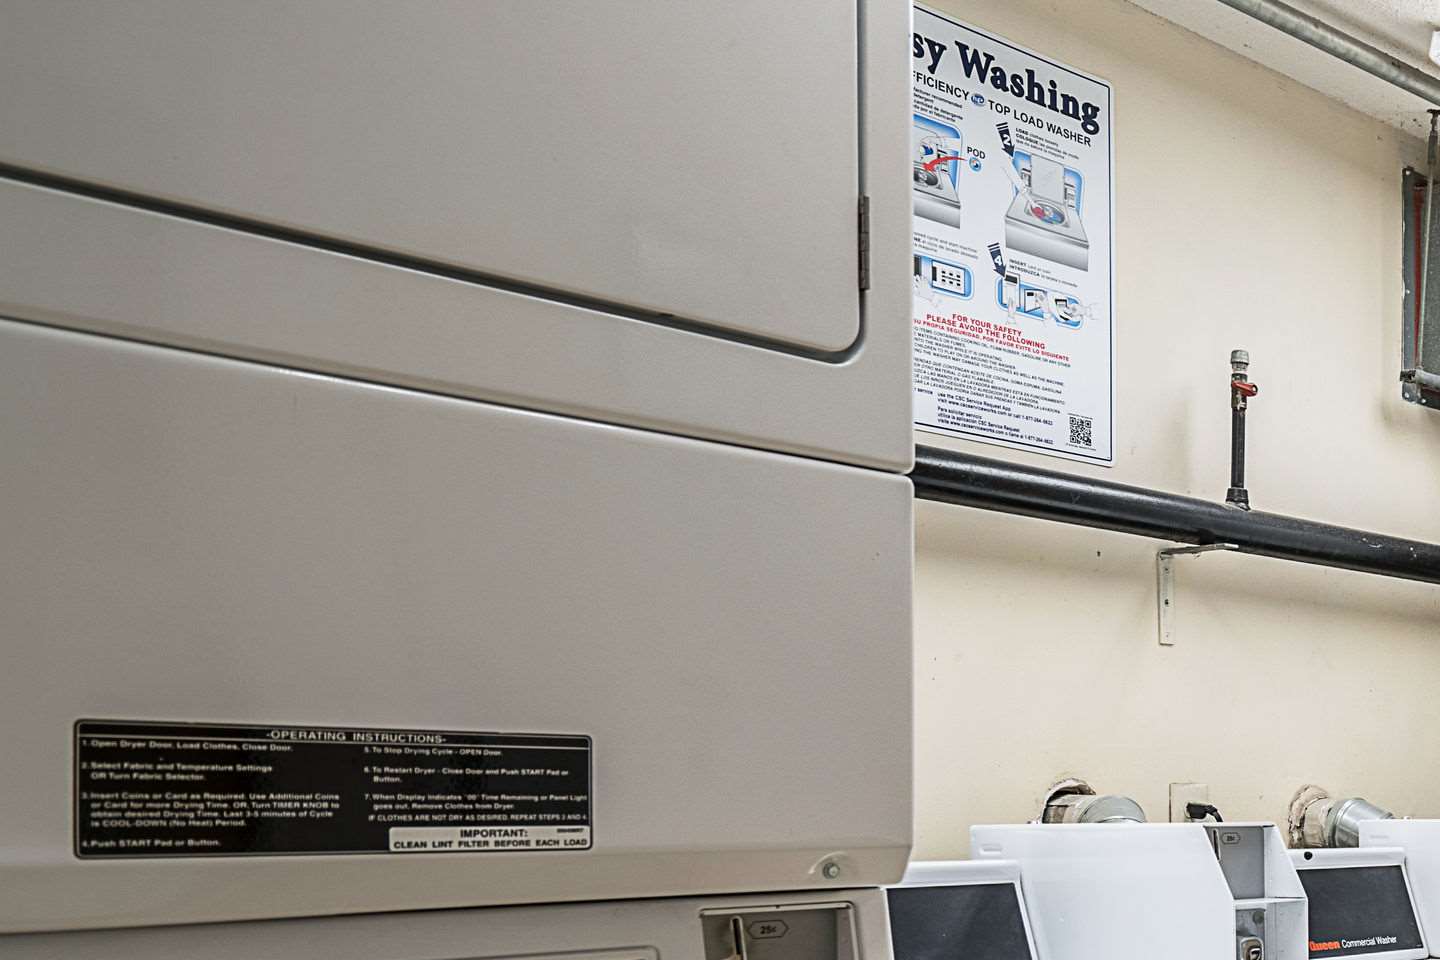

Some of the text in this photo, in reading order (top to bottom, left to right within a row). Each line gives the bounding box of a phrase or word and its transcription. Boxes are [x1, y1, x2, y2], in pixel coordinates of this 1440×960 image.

[954, 40, 1100, 136] Washing
[988, 99, 1010, 116] TOP
[1013, 110, 1044, 129] LOAD
[1046, 121, 1092, 148] WASHER
[1002, 133, 1011, 146] 2
[967, 146, 986, 160] POD
[926, 314, 1046, 350] PLEASE AVOID THE FOLLOWING
[952, 313, 1021, 337] FOR YOUR SAFETY
[922, 321, 945, 331] PROPIA
[982, 335, 994, 343] POR
[995, 338, 1014, 348] FAVOR
[1015, 343, 1031, 352] EVITE
[176, 763, 233, 771] Temperature
[460, 829, 528, 838] IMPORTANT:
[393, 838, 588, 849] CLEAN LINT FILTER BEFORE EACH LOAD
[1341, 936, 1377, 949] Commercial
[1376, 935, 1397, 946] Washer
